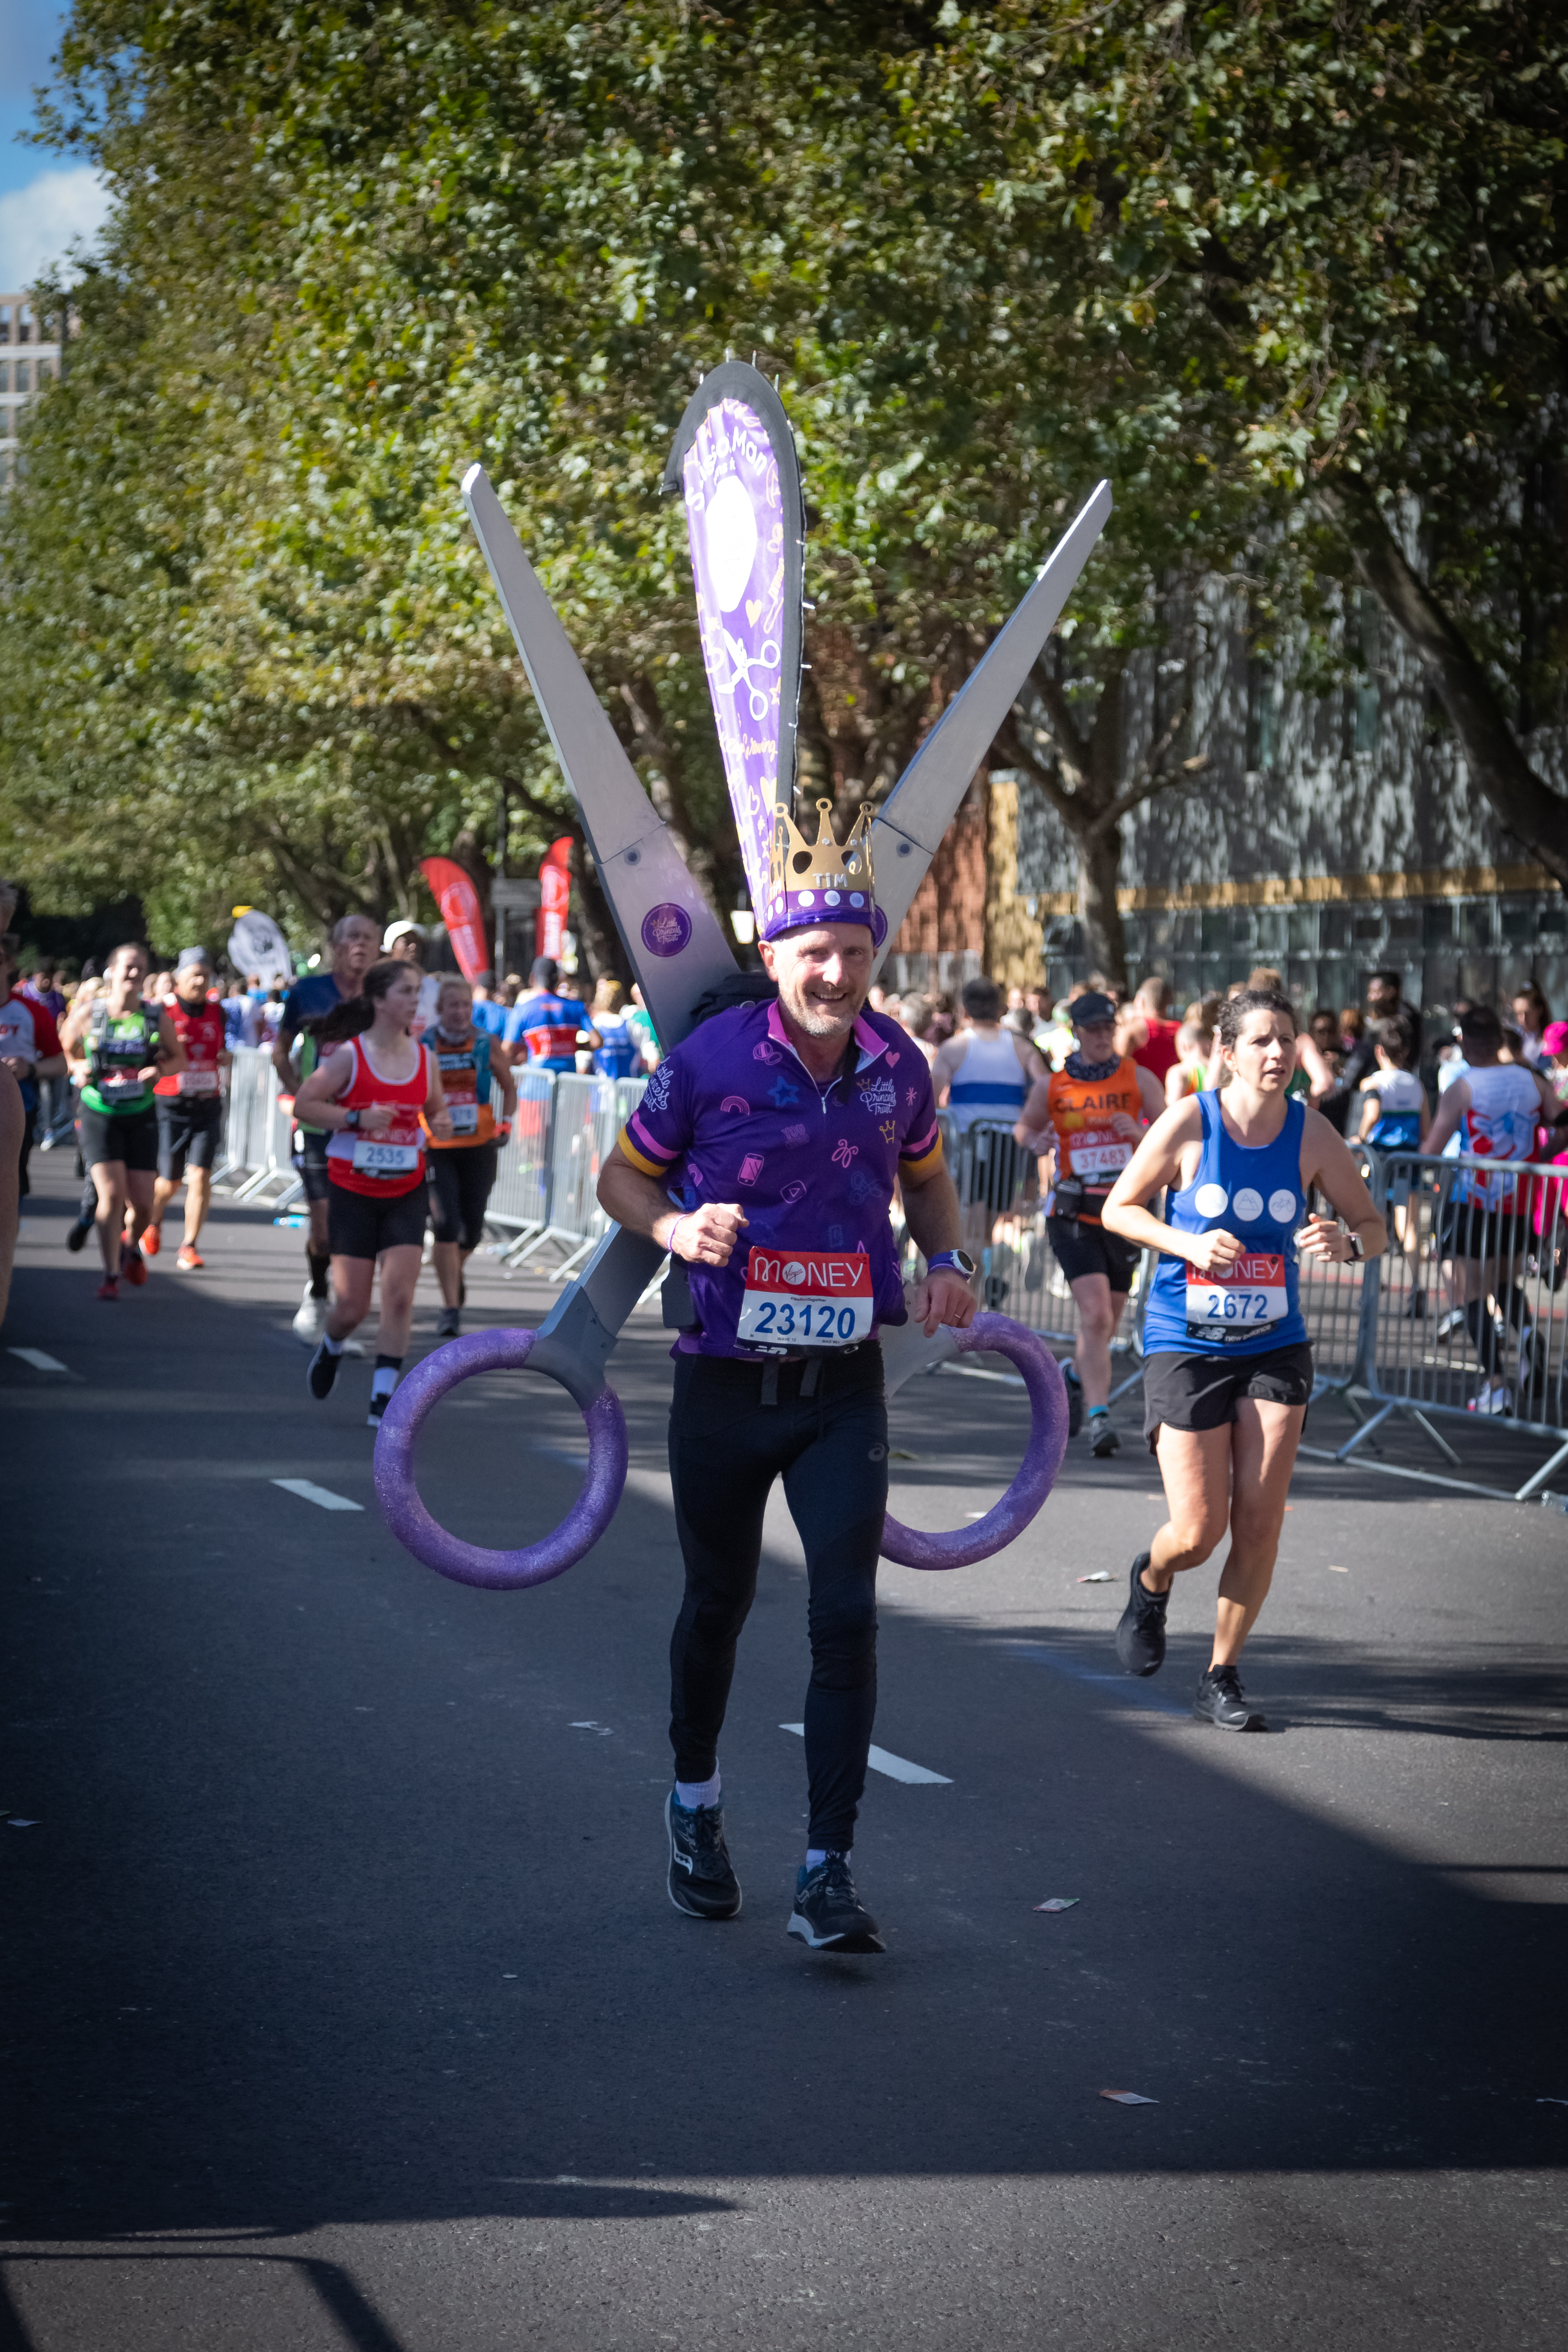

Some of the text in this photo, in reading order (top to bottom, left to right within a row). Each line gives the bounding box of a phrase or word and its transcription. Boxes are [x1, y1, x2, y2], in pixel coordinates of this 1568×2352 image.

[732, 426, 768, 476] Man
[659, 917, 678, 928] Little
[652, 925, 682, 939] Princess
[658, 933, 679, 945] Trust
[870, 1076, 894, 1093] Little
[860, 1092, 897, 1108] Princess
[868, 1102, 893, 1116] Trust
[781, 1124, 806, 1140] YOU
[366, 1146, 406, 1165] 2535
[754, 1257, 864, 1287] MONEY
[784, 1265, 804, 1282] Virgin
[1207, 1294, 1268, 1319] 2672
[754, 1302, 856, 1339] 23120
